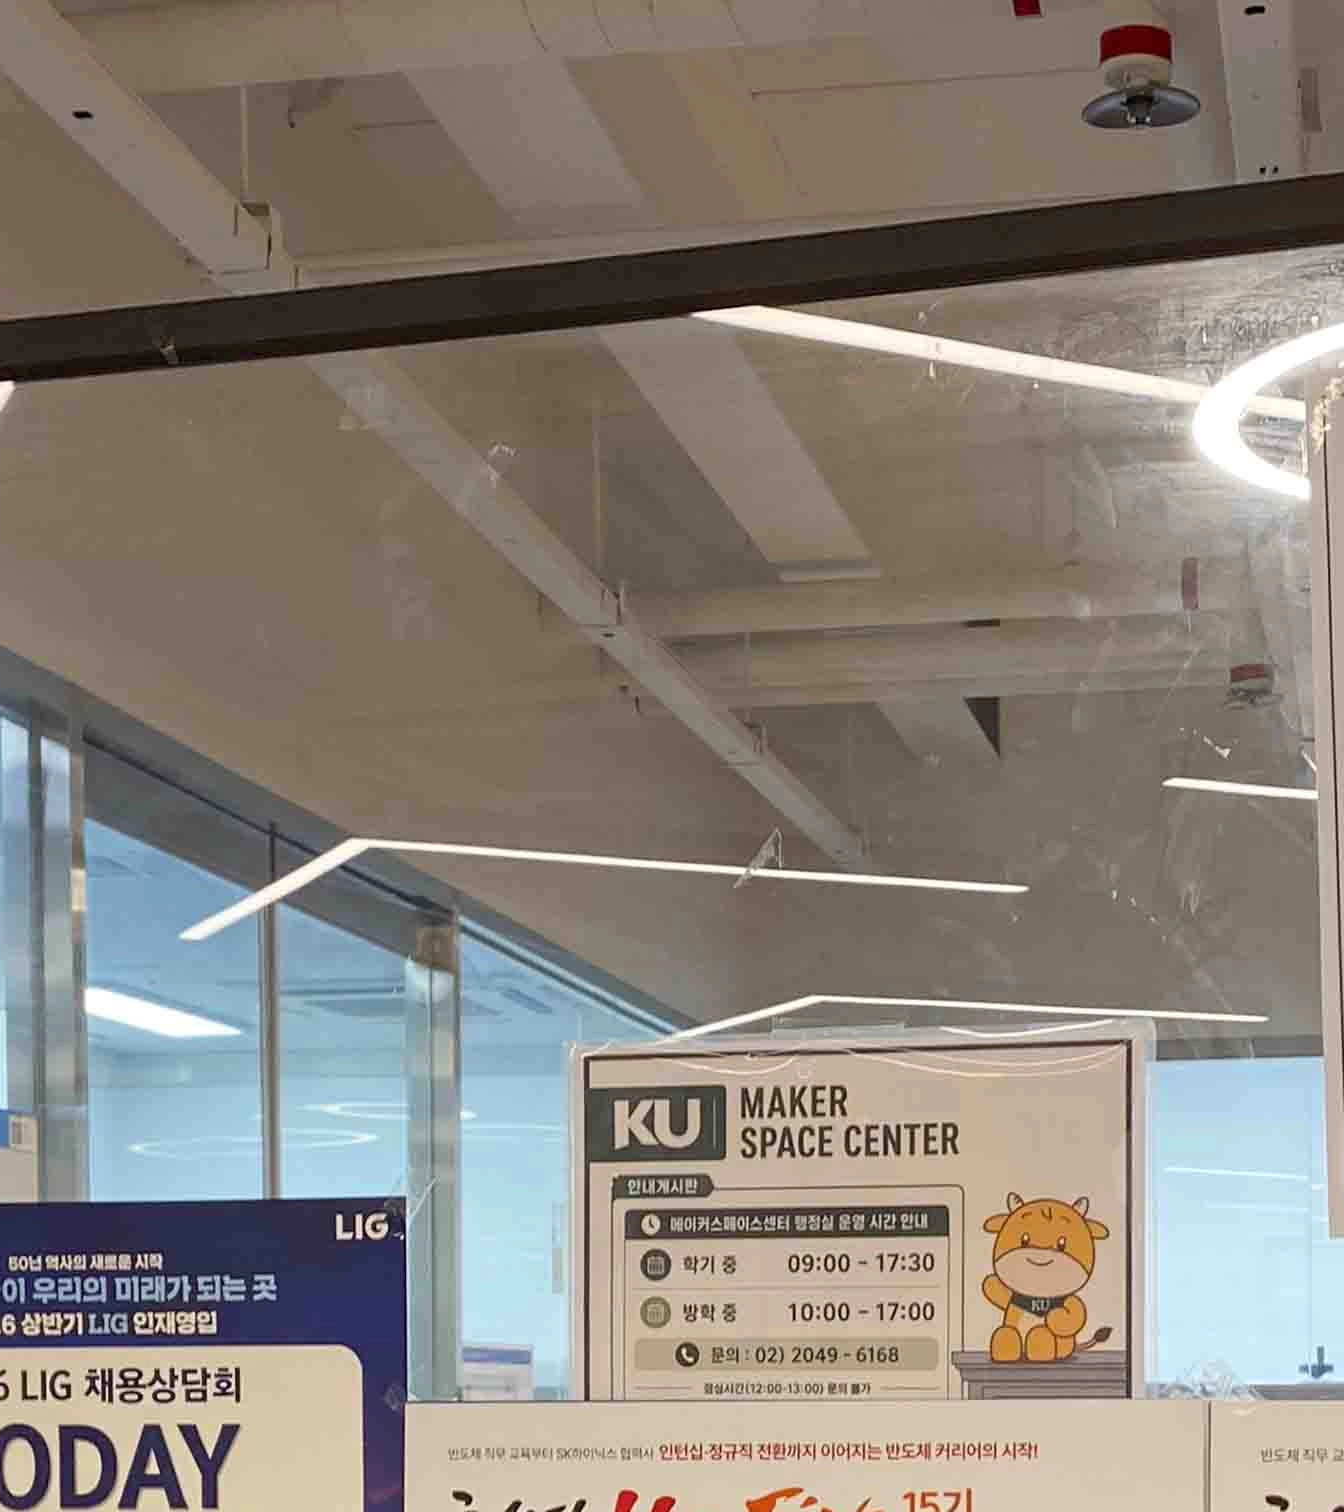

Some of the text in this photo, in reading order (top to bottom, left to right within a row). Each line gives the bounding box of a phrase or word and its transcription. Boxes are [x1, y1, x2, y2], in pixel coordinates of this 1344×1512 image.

[741, 1085, 847, 1119] MAKER
[614, 1099, 700, 1149] KU
[741, 1123, 959, 1158] SPACE CENTER
[628, 1178, 698, 1195] 안내게시판
[336, 1213, 388, 1240] LIG
[671, 1213, 928, 1232] 메이커스페이스센터 행정실 운영 시간 안내
[684, 1256, 736, 1274] 학기 중
[788, 1253, 934, 1272] 09:00 17:30
[33, 1276, 106, 1304] 우리의
[114, 1275, 191, 1302] 미래가
[197, 1275, 246, 1301] 되는
[252, 1274, 277, 1301] 곳
[683, 1304, 736, 1323] 방학 중
[789, 1302, 934, 1321] 10:00 17:00
[21, 1312, 83, 1336] 상반기
[88, 1313, 128, 1334] LIG
[133, 1311, 217, 1334] 인재영입
[712, 1346, 898, 1363] 문의 02) 2049 6168
[21, 1370, 71, 1400] LIG
[85, 1368, 240, 1404] 채용상담회
[1261, 1448, 1300, 1464] 반도체
[1303, 1448, 1328, 1464] 직무
